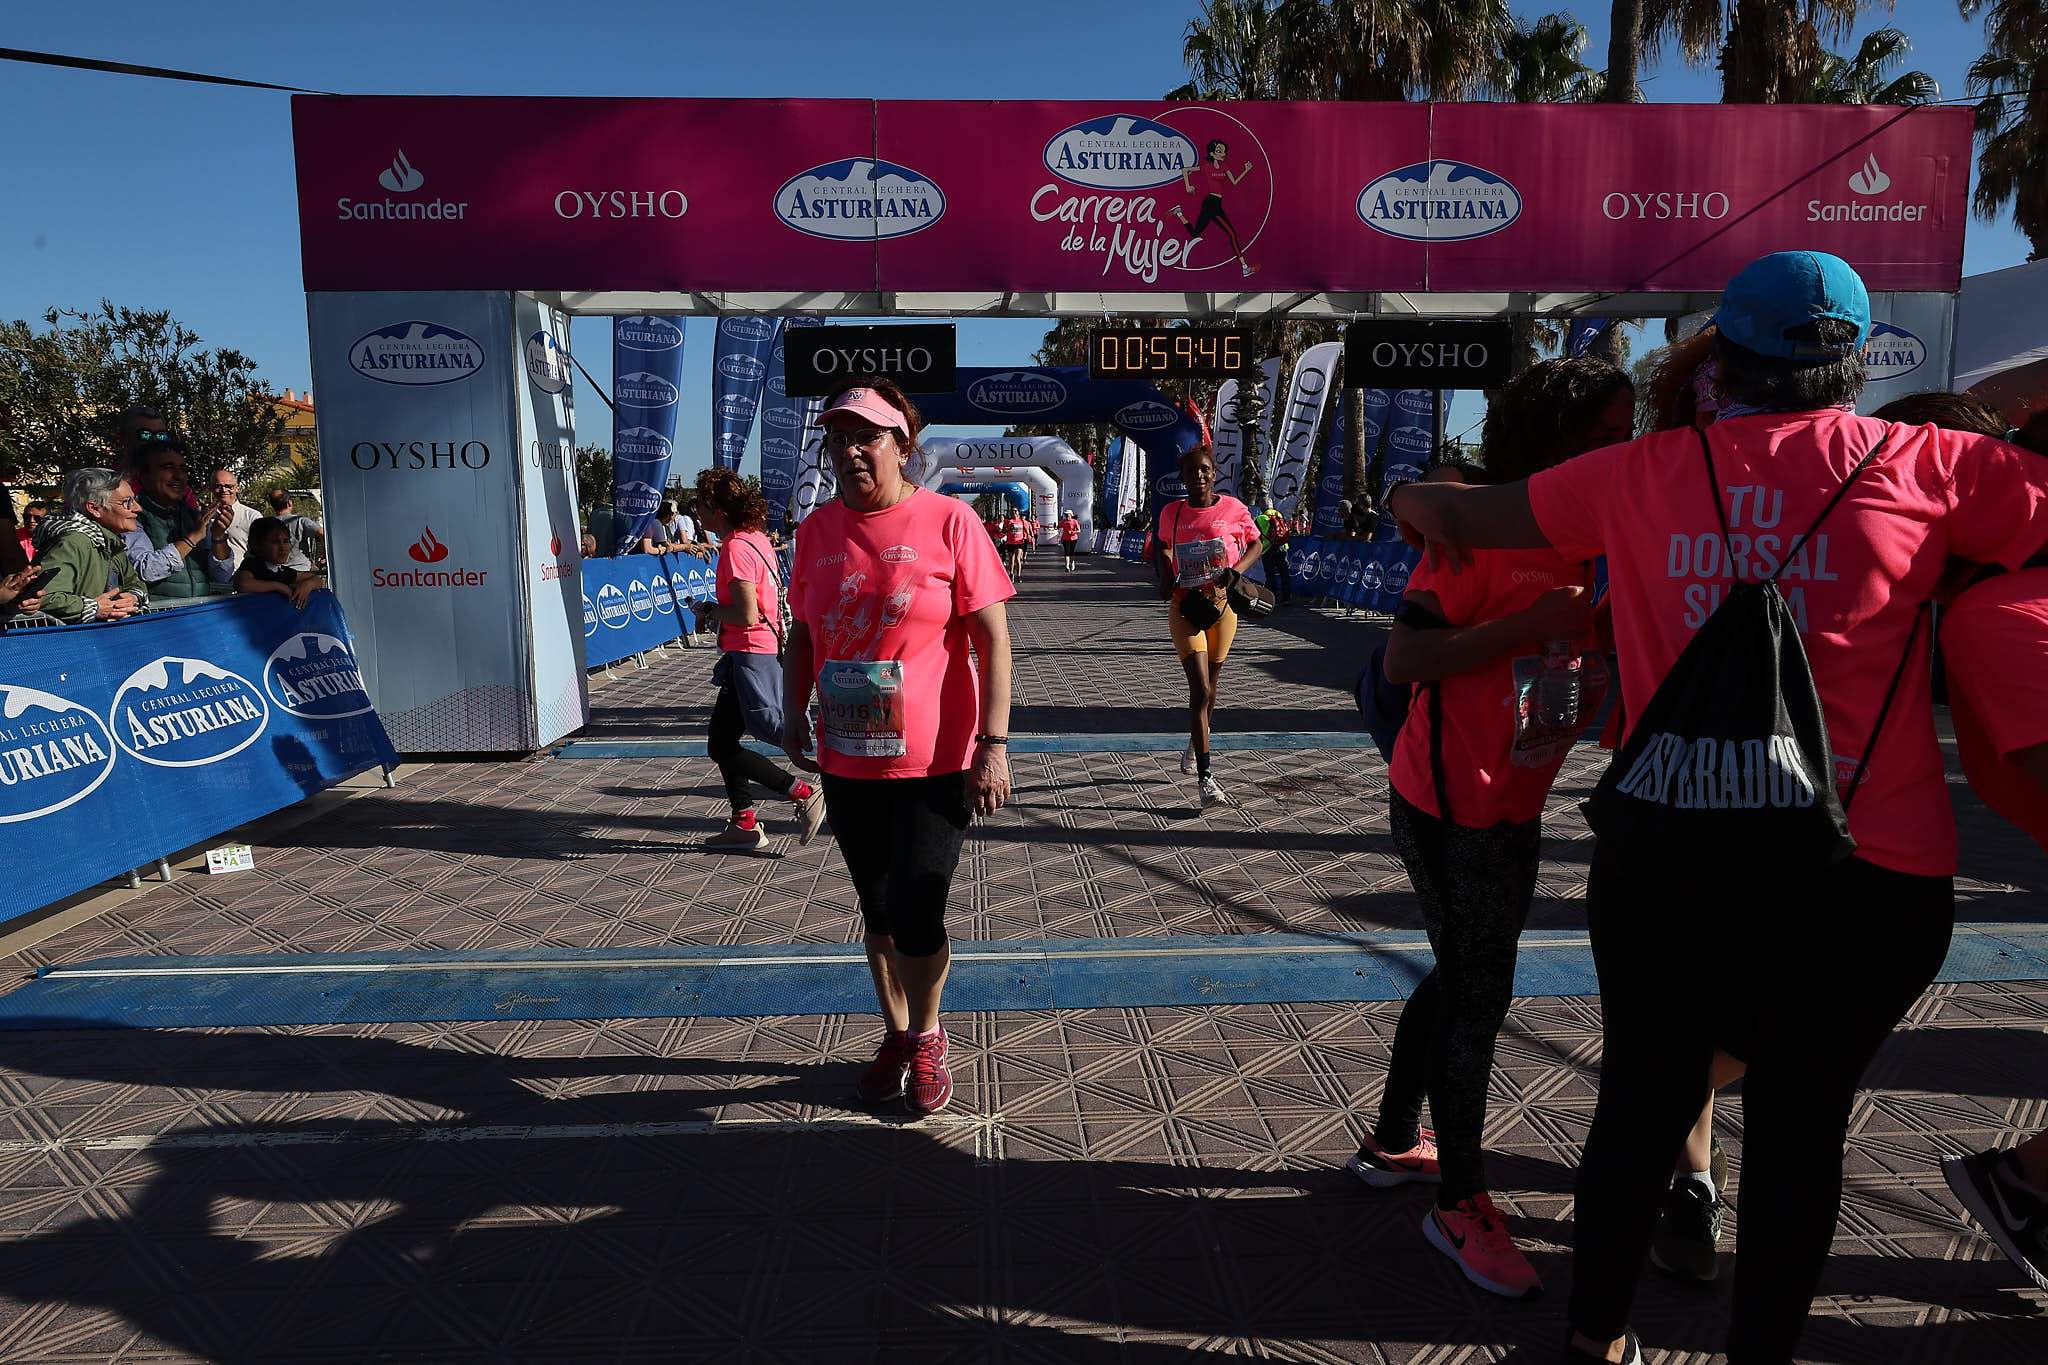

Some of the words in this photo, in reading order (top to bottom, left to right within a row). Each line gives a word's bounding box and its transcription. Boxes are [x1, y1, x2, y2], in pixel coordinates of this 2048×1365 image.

[1056, 142, 1185, 170] ASTURIANA
[1079, 140, 1129, 148] CENTRAL
[788, 184, 932, 219] ASTURIANA
[813, 186, 866, 194] CENTRAL
[1030, 183, 1157, 223] Carrera
[1395, 187, 1444, 196] CENTRAL
[1448, 187, 1504, 196] LECHERA
[337, 197, 468, 221] Santander
[554, 190, 689, 219] OYSHO
[1369, 188, 1510, 221] ASTURIANA
[1602, 191, 1730, 220] OYSHO
[1807, 199, 1927, 222] Santander
[1061, 228, 1085, 252] de
[1089, 225, 1107, 252] la
[1102, 221, 1204, 283] Mujer
[359, 345, 476, 370] ASTURIANA
[812, 347, 932, 374] OYSHO
[1101, 336, 1241, 369] 00:59:46
[1372, 342, 1488, 369] OYSHO
[1865, 350, 1916, 366] RIANA
[975, 385, 1060, 403] ASTURIANA
[1399, 393, 1433, 409] ASTURIA
[1119, 410, 1174, 425] ASTURIANA
[351, 440, 491, 471] OYSHO
[531, 440, 572, 471] OYSHO
[956, 443, 1034, 460] OYSHO
[1727, 485, 1783, 529] TU
[1667, 532, 1838, 582] DORSAL
[373, 567, 488, 588] Santander
[541, 563, 574, 581] Santander
[1511, 570, 1554, 583] OYSHO
[141, 692, 190, 713] CENTRAL
[193, 681, 242, 702] LECHERA
[21, 715, 87, 738] LECHERA
[125, 694, 264, 752] ASTURIANA
